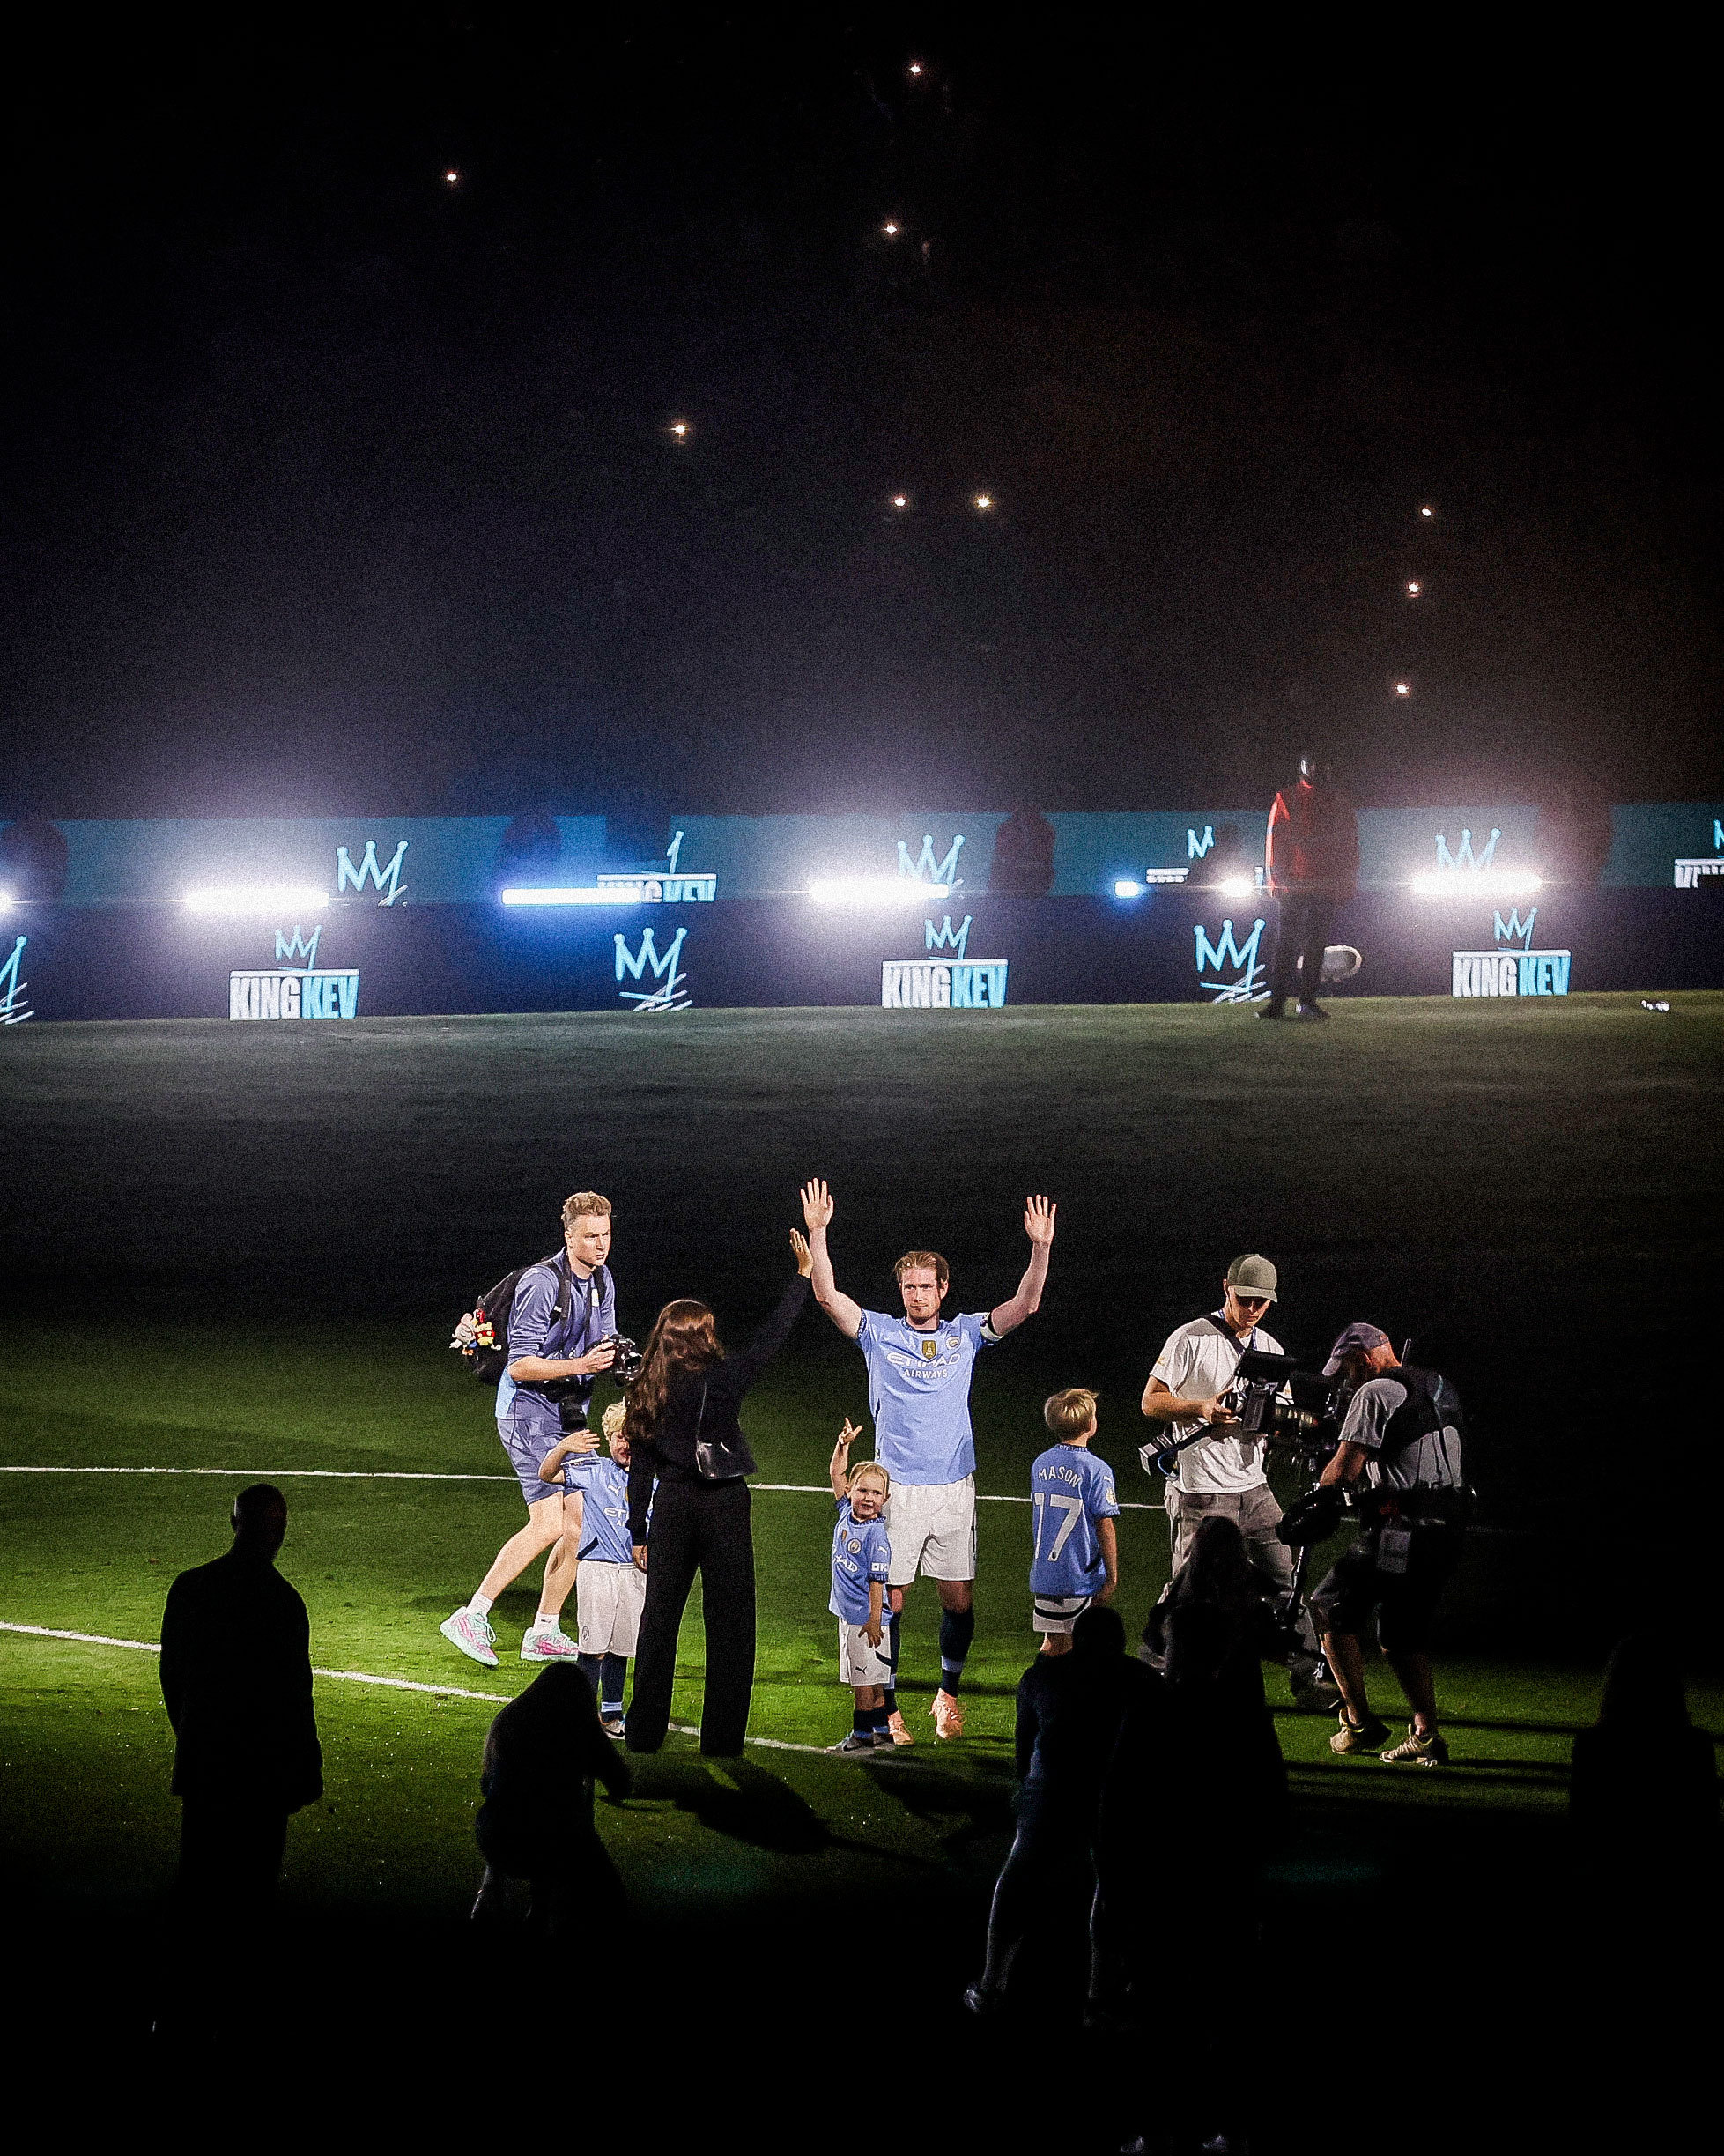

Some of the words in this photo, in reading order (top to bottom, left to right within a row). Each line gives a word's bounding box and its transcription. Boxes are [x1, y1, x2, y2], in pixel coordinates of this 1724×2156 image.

[903, 1367, 948, 1379] AIRWAYS
[1038, 1465, 1083, 1488] MASON
[1033, 1493, 1084, 1561] 17
